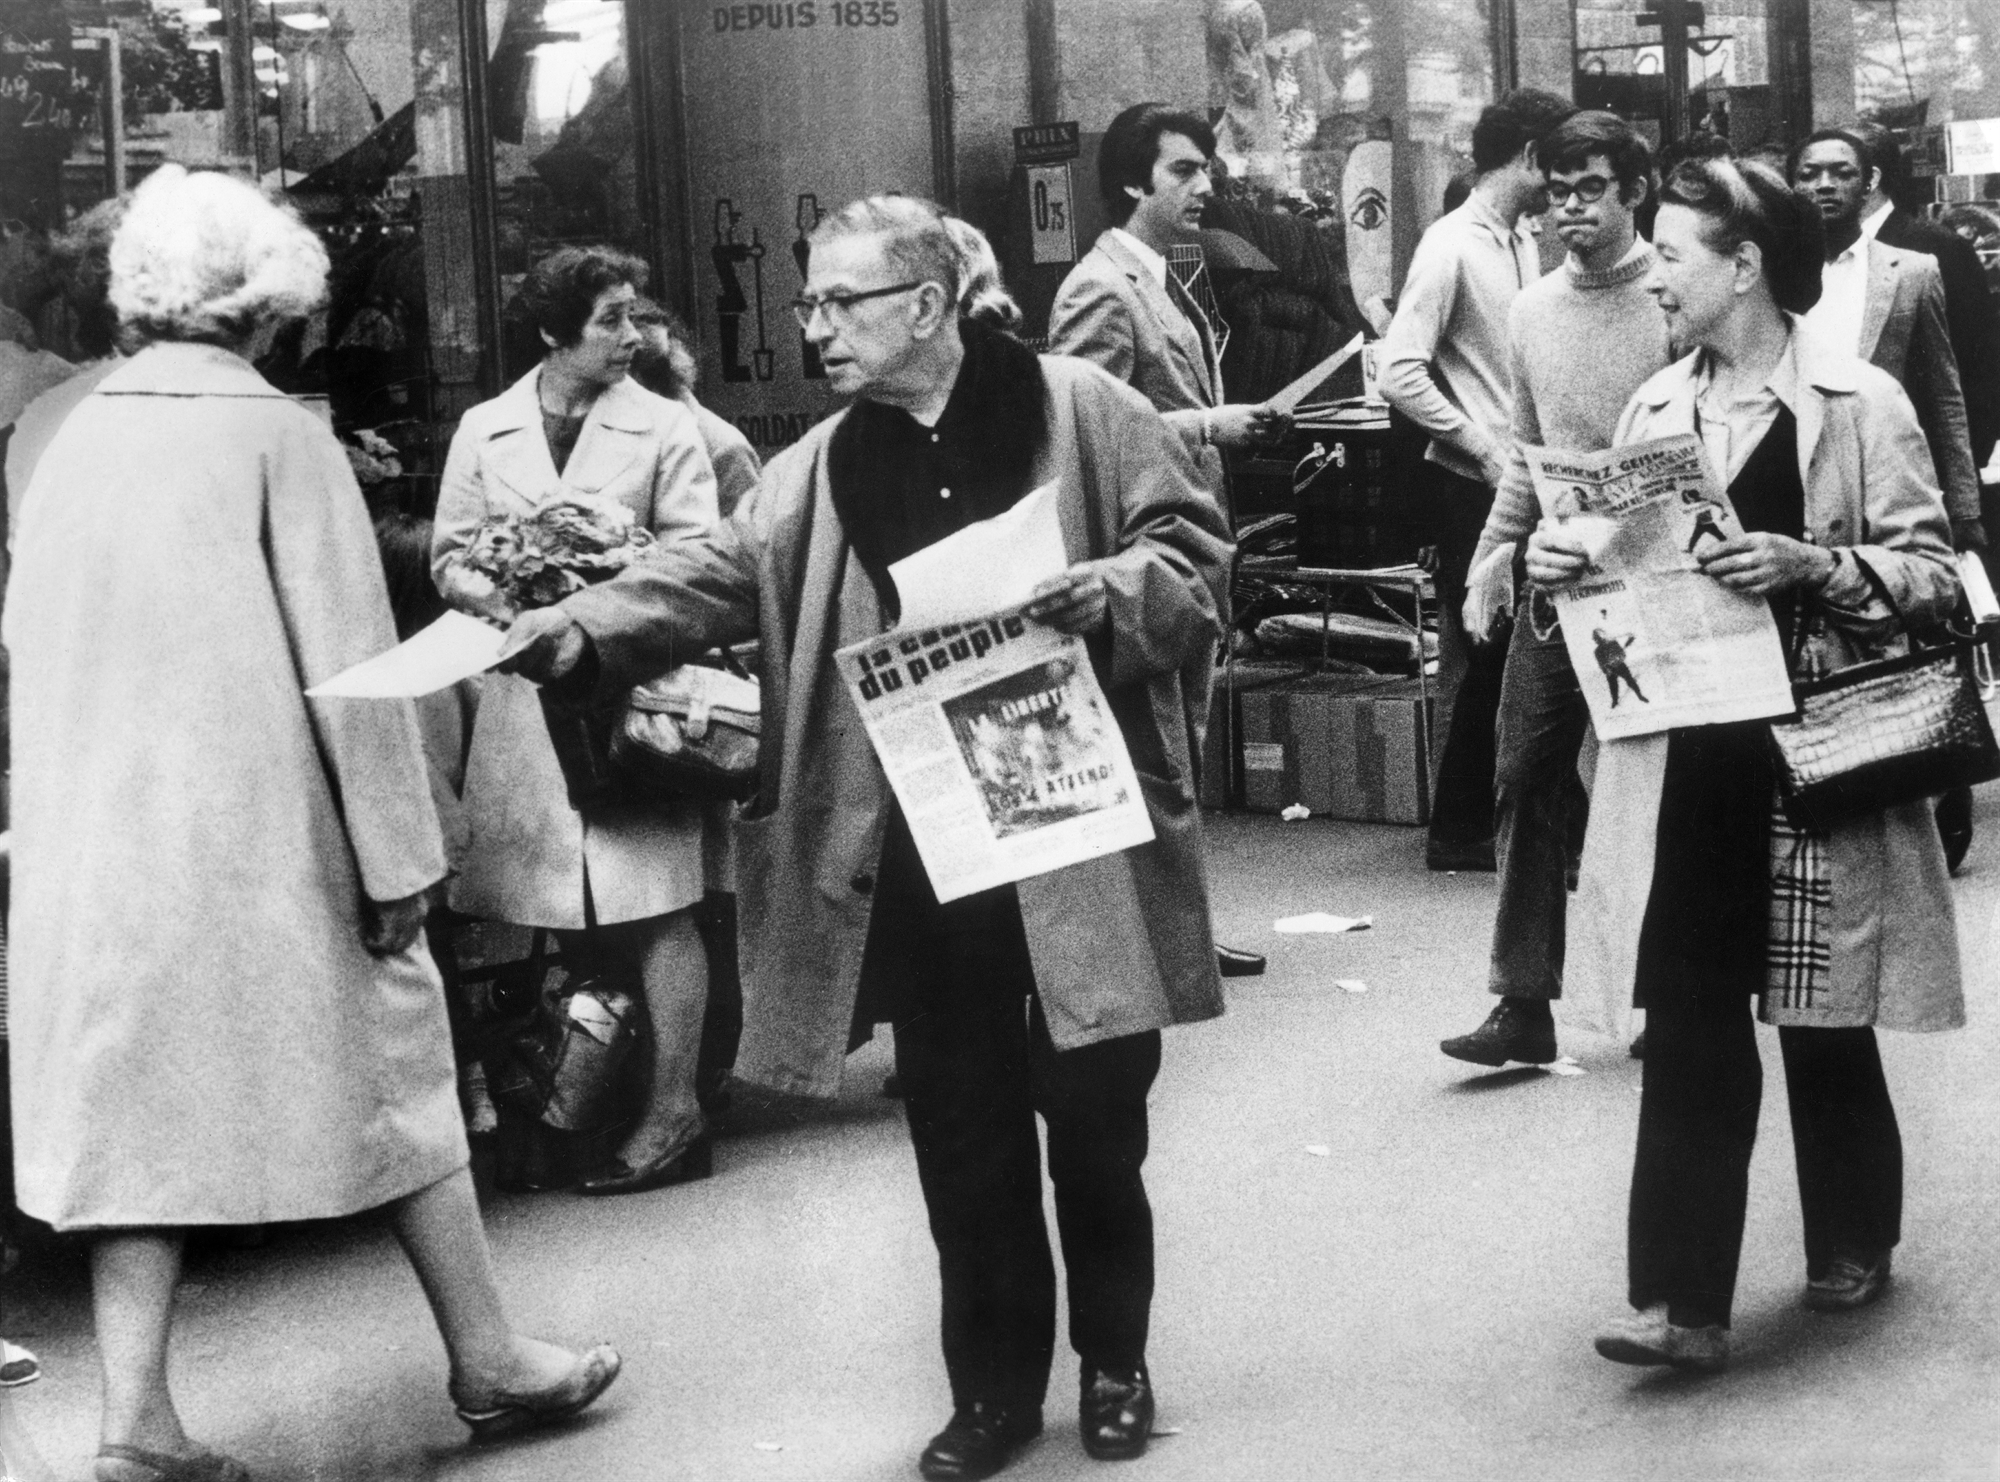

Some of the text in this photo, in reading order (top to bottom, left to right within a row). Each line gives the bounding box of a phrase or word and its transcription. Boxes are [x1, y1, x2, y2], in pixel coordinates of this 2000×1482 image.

[713, 1, 900, 32] DEPUIS 1835
[737, 412, 810, 448] SOLDAT
[858, 615, 1025, 701] du peuple
[858, 648, 892, 674] la
